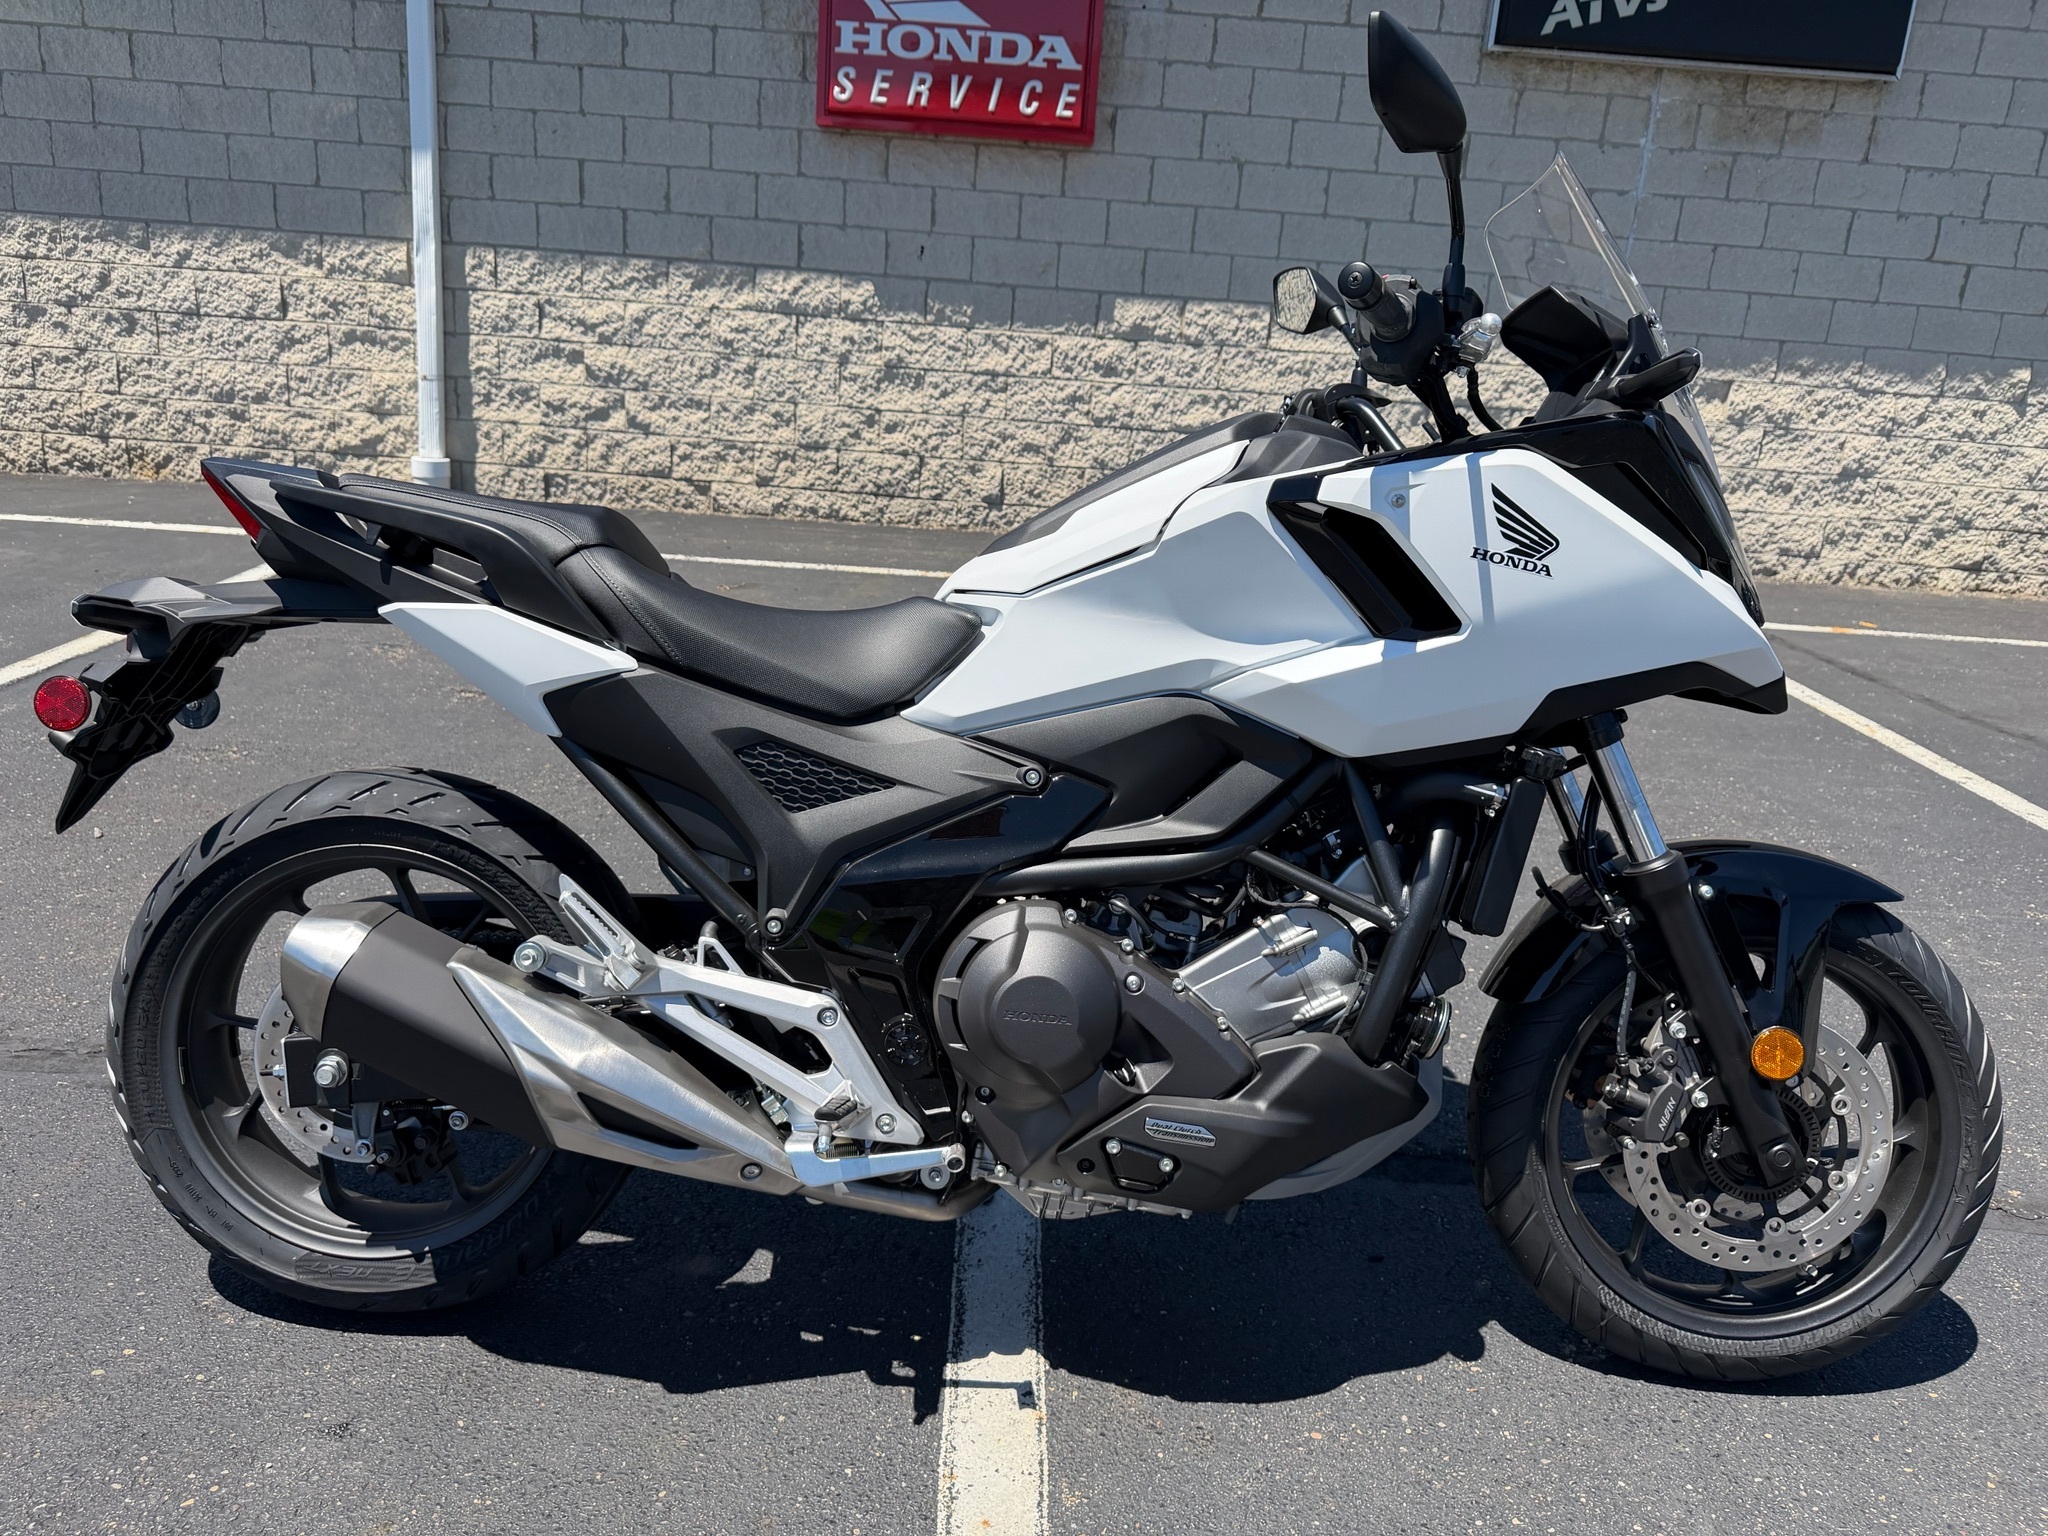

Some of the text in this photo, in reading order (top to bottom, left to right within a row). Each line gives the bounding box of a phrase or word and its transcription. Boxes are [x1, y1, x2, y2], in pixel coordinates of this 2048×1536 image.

[835, 20, 1082, 70] HONDA
[833, 66, 1080, 119] SERVICE
[1470, 547, 1553, 578] HONDA
[1003, 1010, 1073, 1026] HONDA
[1151, 1121, 1202, 1135] Dual Clutch
[1658, 1096, 1676, 1132] NISSIN
[1152, 1129, 1215, 1144] Transmission
